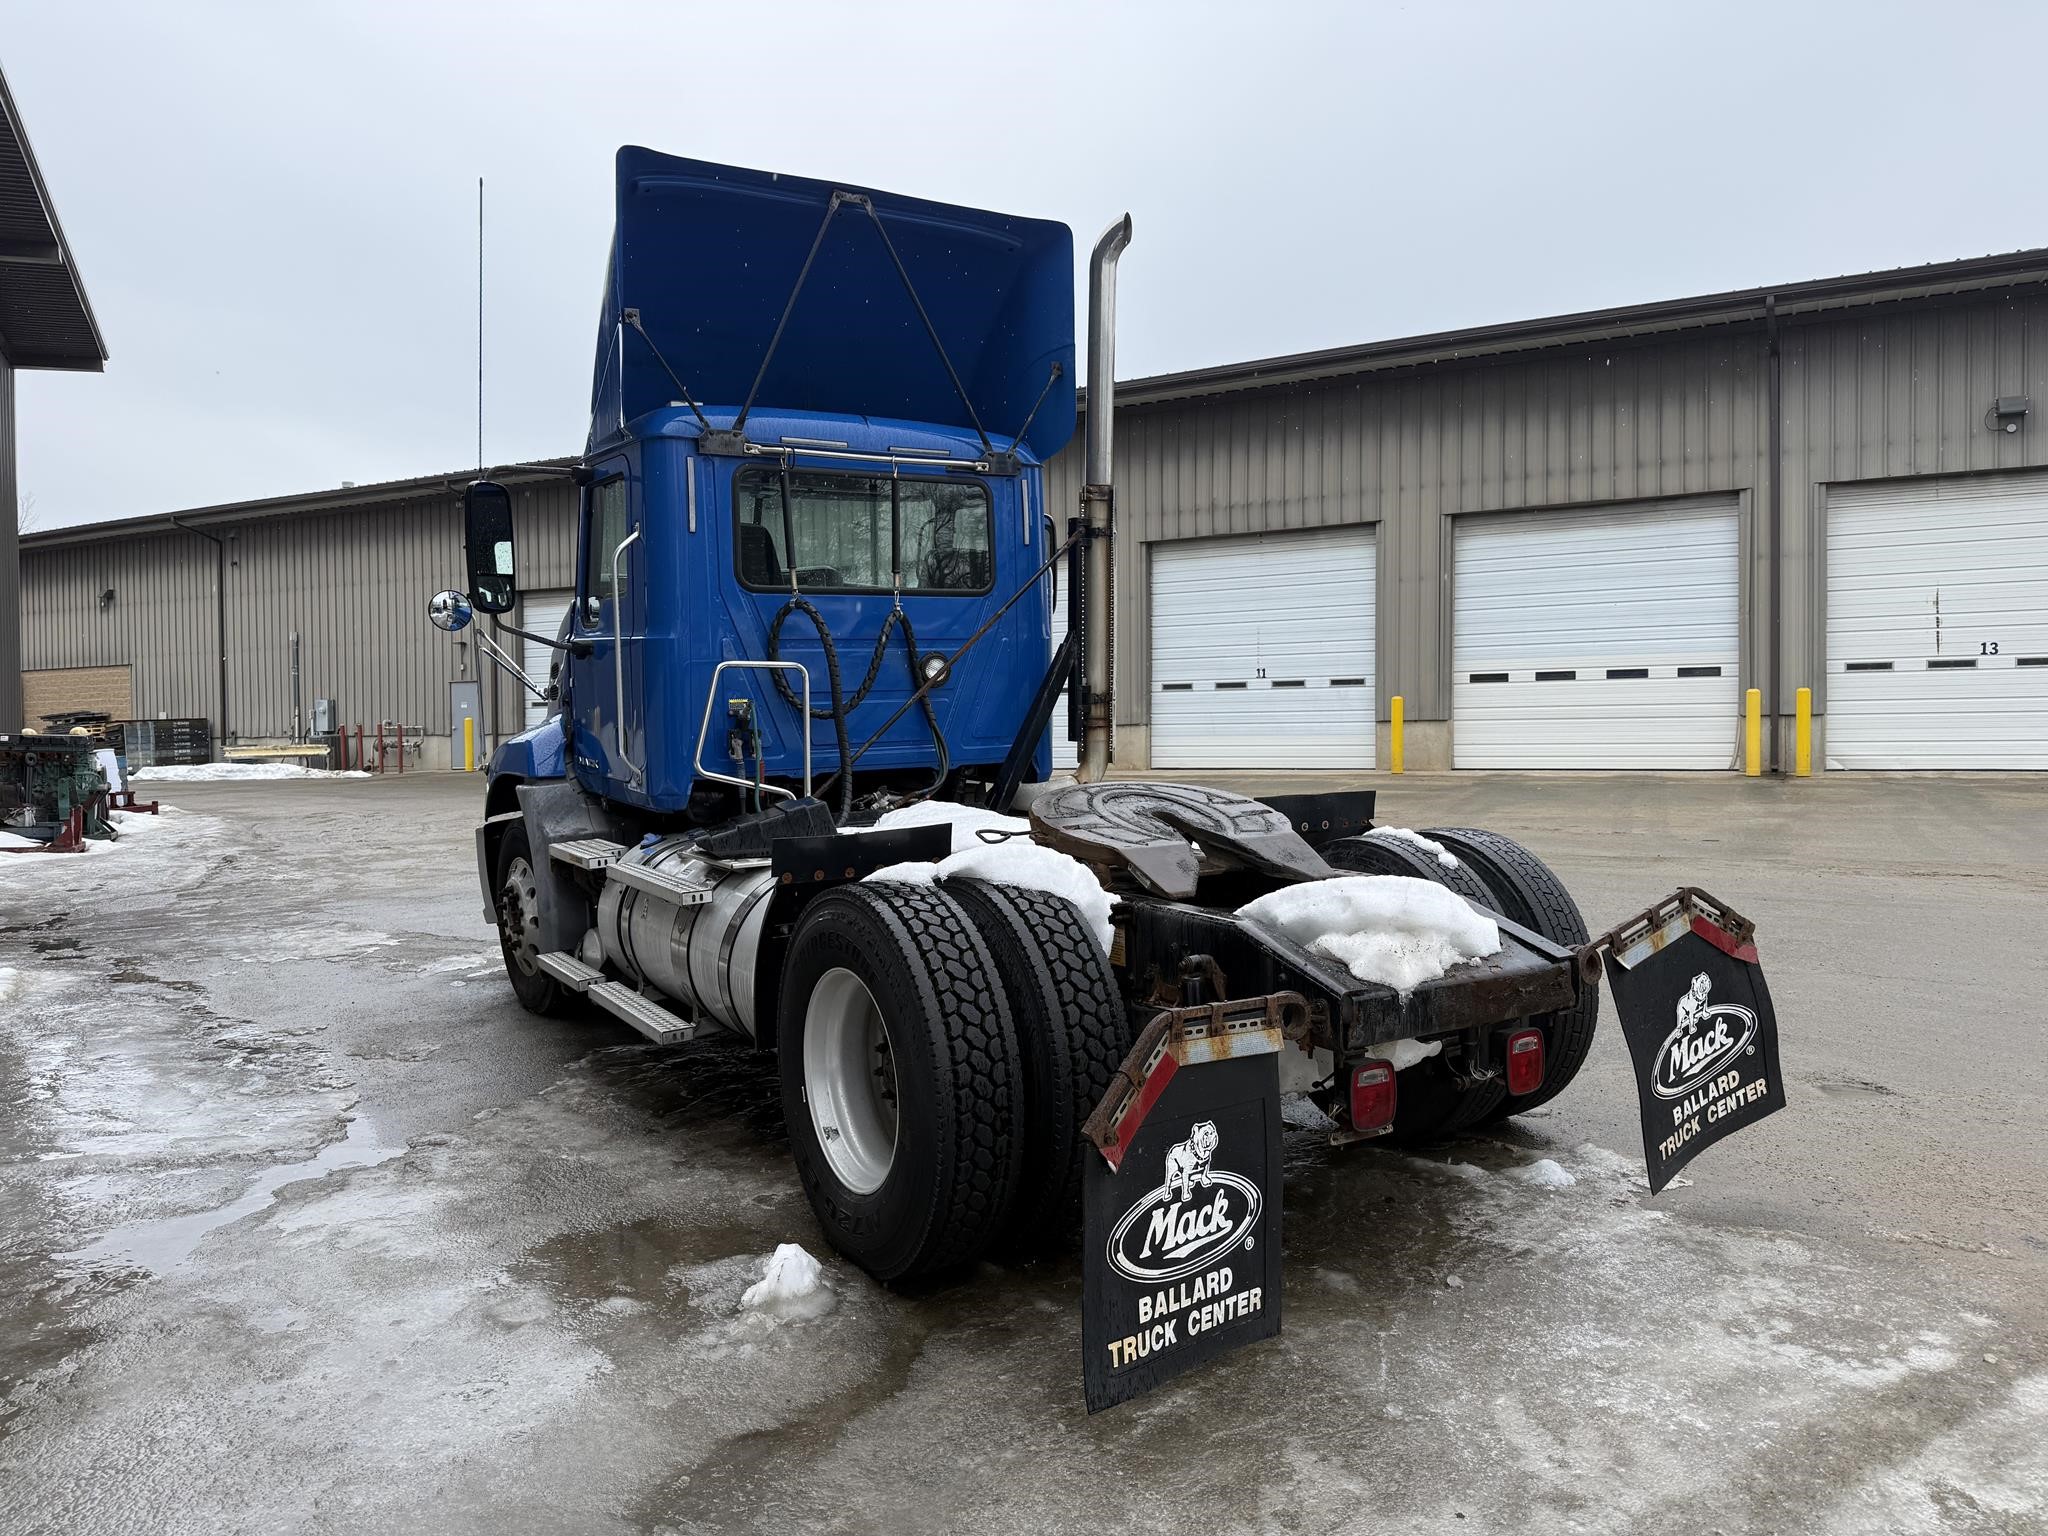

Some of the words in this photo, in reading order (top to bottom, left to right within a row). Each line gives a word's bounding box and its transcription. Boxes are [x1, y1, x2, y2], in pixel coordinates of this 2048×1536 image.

[1256, 667, 1266, 679] 11
[1980, 642, 1999, 655] 13
[1668, 1017, 1734, 1083] Mack
[1658, 1114, 1702, 1161] TRUCK
[1707, 1078, 1768, 1123] CENTER
[1672, 1069, 1740, 1126] BALLARD
[1139, 1188, 1233, 1259] Mack
[1138, 1266, 1233, 1325] BALLARD
[1107, 1318, 1178, 1368] TRUCK
[1187, 1286, 1262, 1337] CENTER
